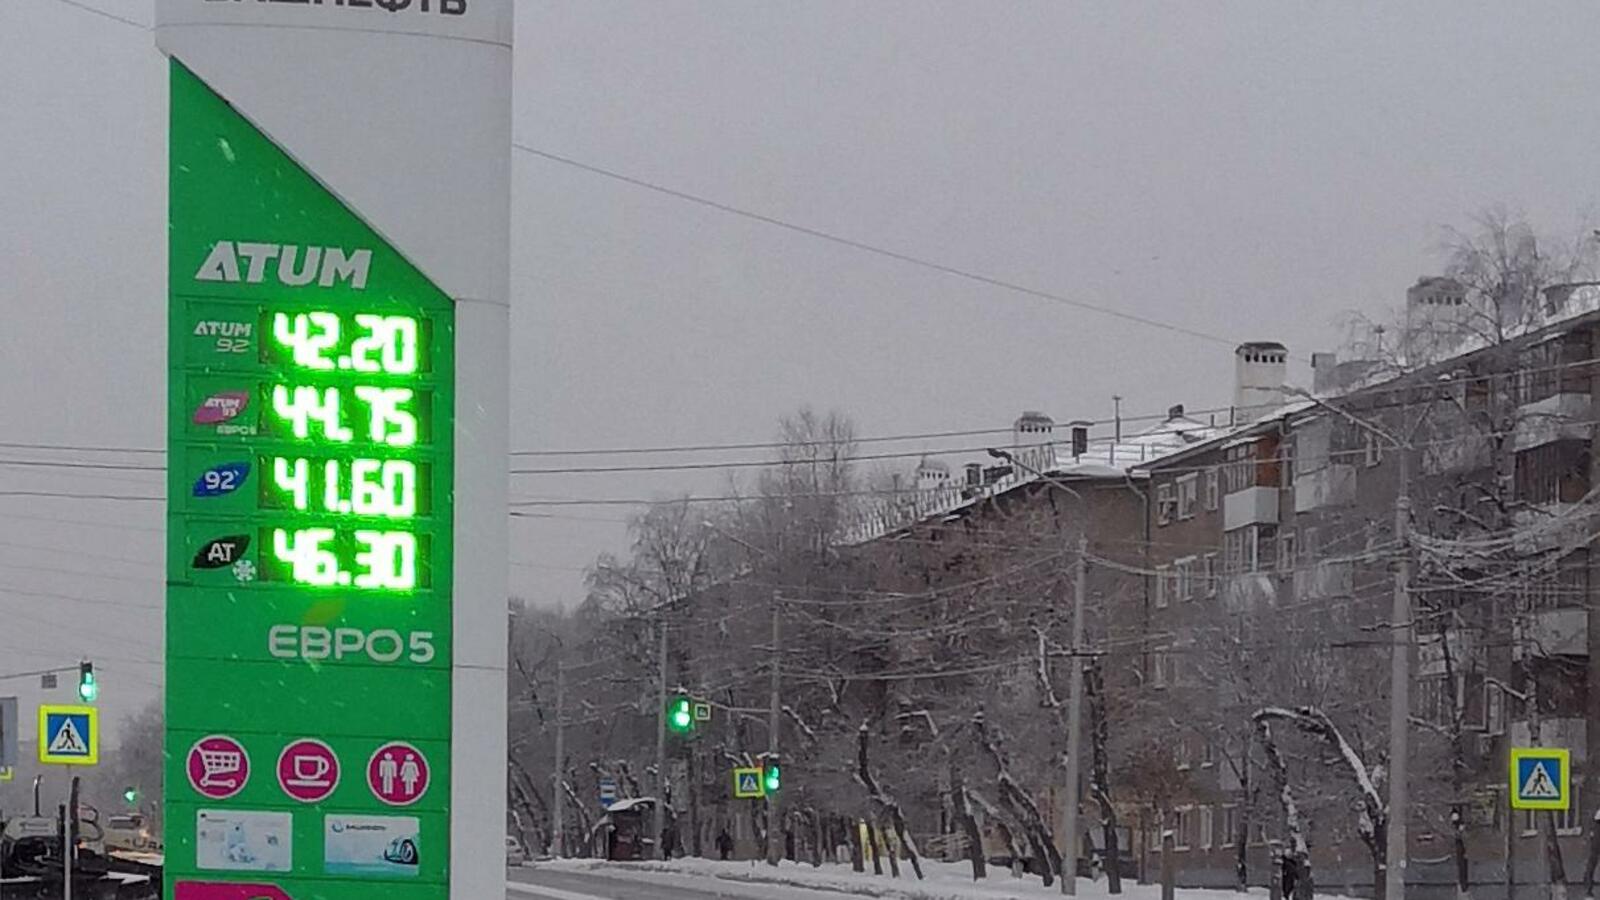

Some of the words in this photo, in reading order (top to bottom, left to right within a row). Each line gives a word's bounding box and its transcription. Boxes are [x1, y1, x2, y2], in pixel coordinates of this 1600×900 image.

[194, 240, 373, 289] ATUM
[193, 320, 252, 337] ATUM
[216, 338, 250, 352] 92
[273, 311, 418, 374] 42.20
[272, 384, 418, 447] 44.75
[273, 456, 416, 517] 41.60
[272, 528, 416, 589] 46.30
